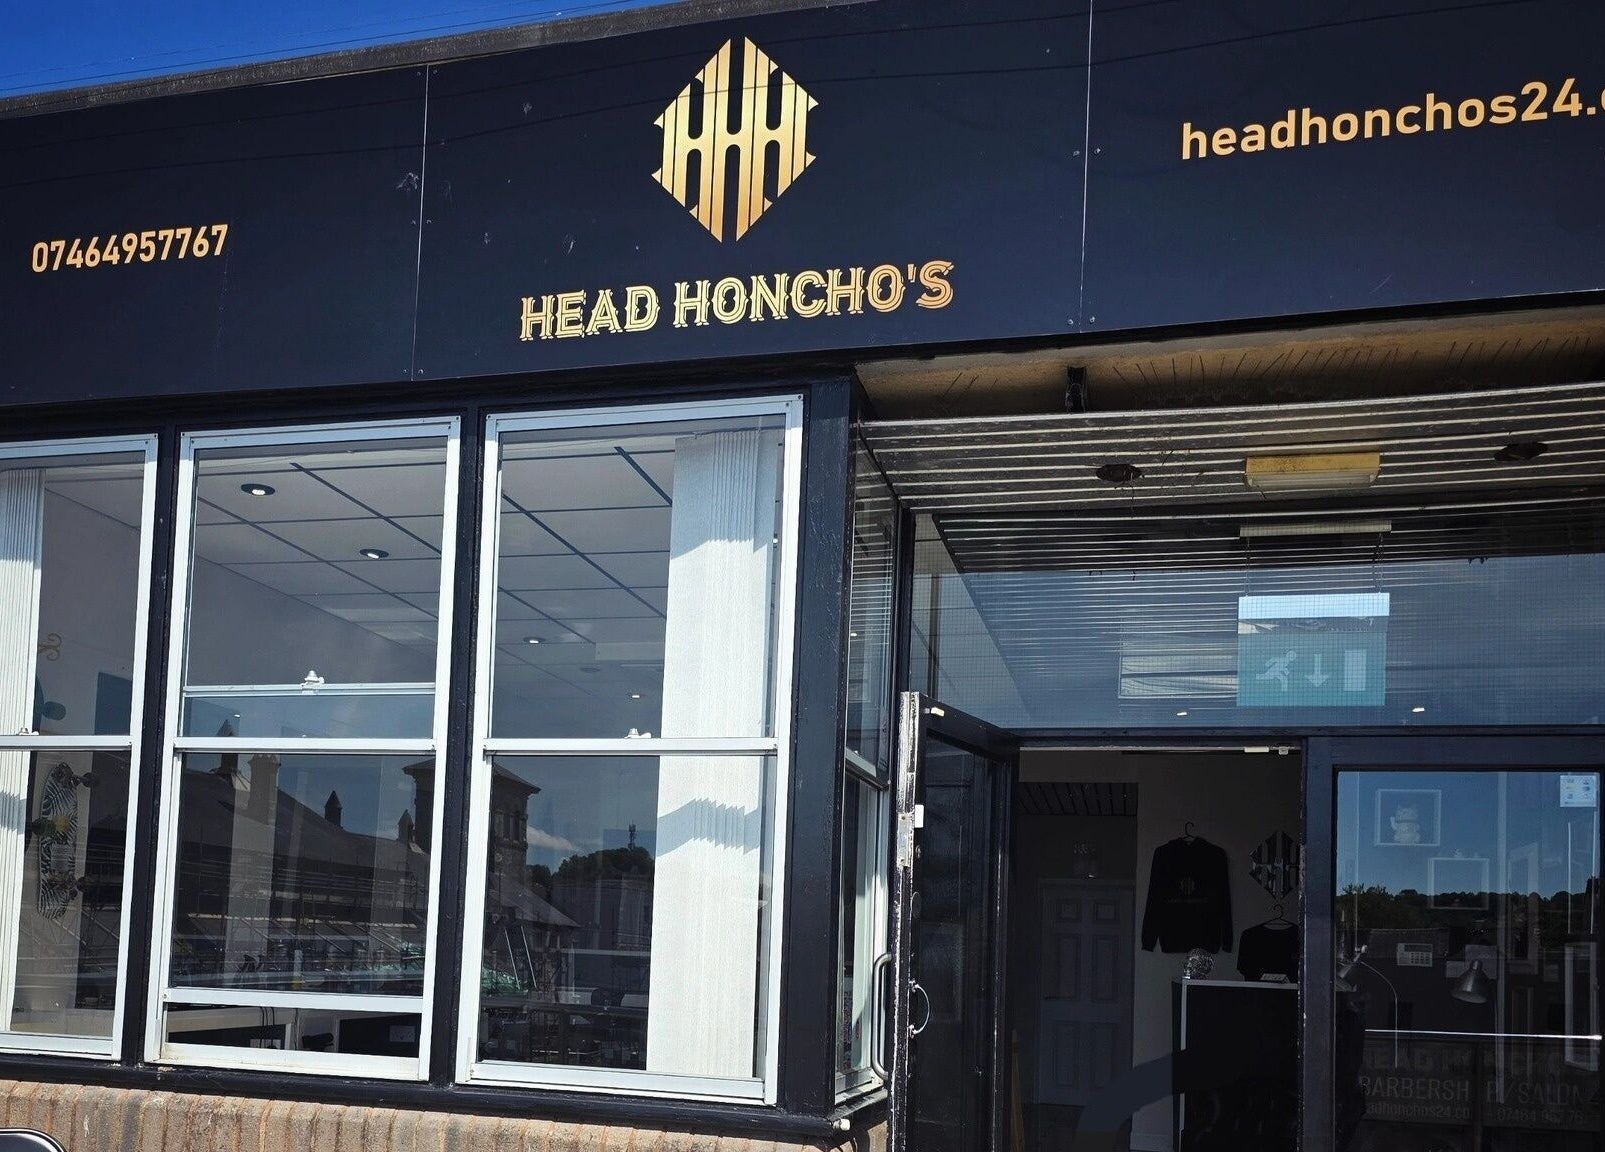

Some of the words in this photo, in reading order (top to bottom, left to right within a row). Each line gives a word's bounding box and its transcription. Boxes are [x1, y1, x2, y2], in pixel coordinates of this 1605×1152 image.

[31, 223, 228, 273] 07464957767
[519, 286, 658, 342] HEAD
[673, 260, 956, 328] HONCHO'S
